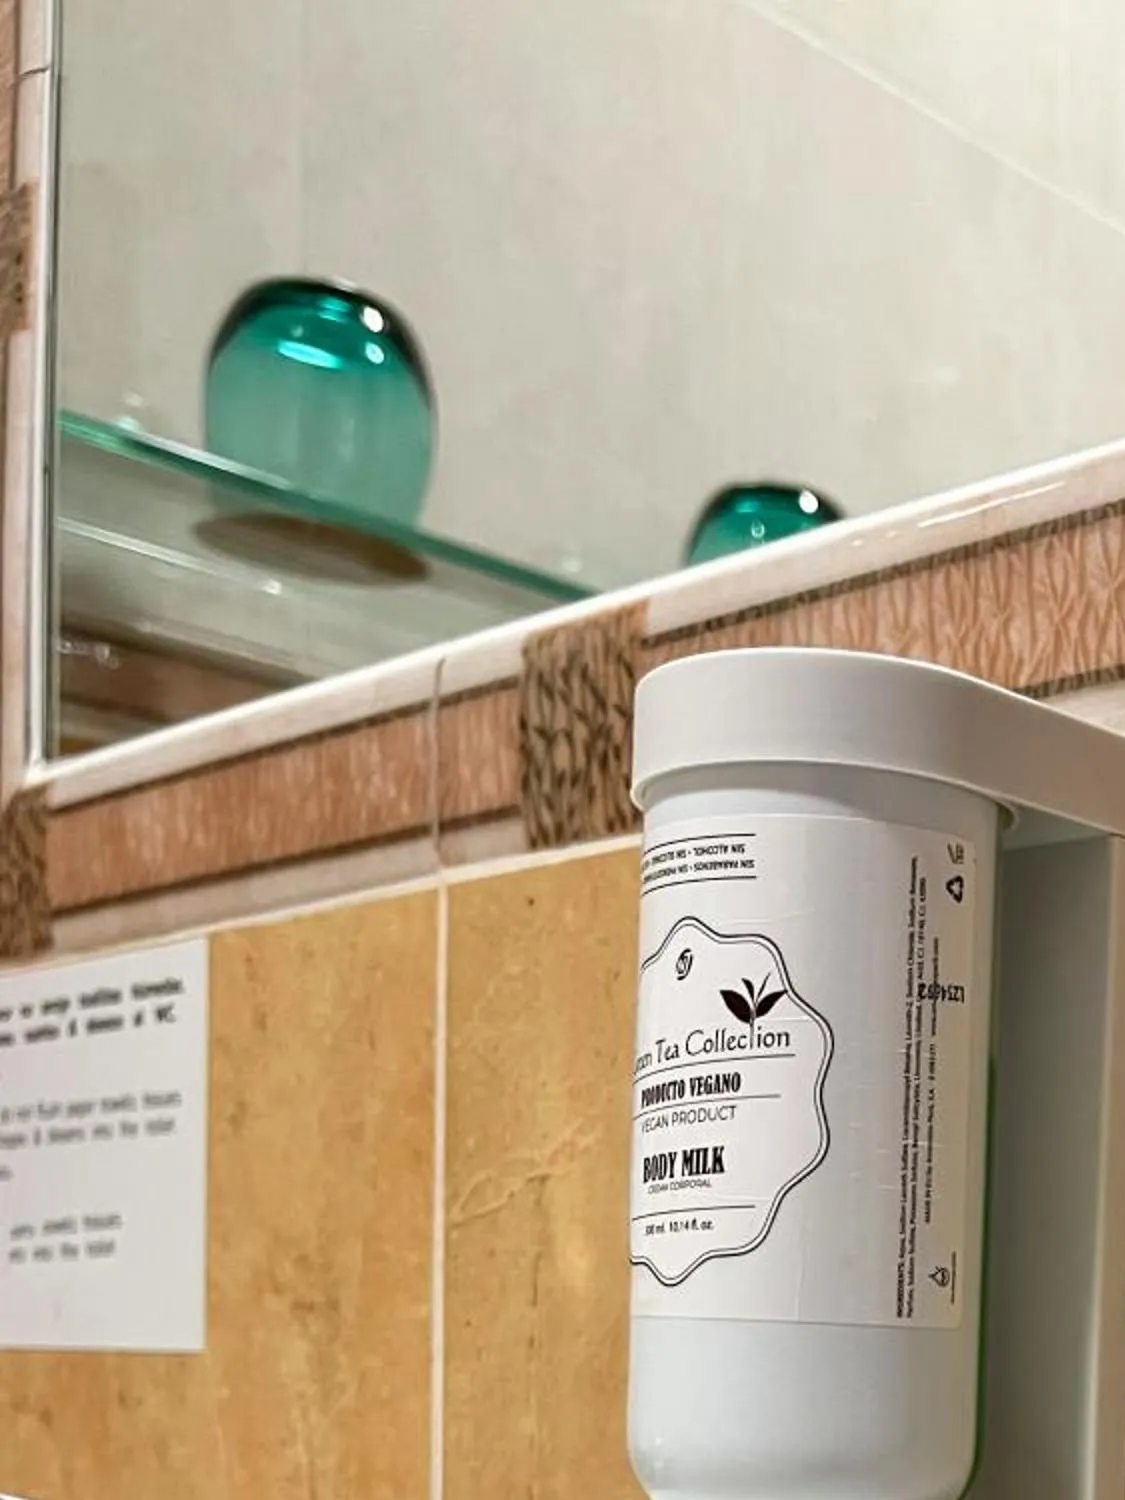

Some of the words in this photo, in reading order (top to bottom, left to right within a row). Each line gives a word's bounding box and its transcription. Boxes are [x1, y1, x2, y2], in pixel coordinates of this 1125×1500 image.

[693, 844, 729, 857] ALCOHOL
[655, 1038, 680, 1064] Tea
[685, 1026, 791, 1057] Collection
[641, 1078, 686, 1109] PRODUCTO
[689, 1071, 742, 1097] VEGANO
[671, 1105, 737, 1126] PRODUCT
[643, 1151, 678, 1184] BODY
[681, 1145, 726, 1177] MILK
